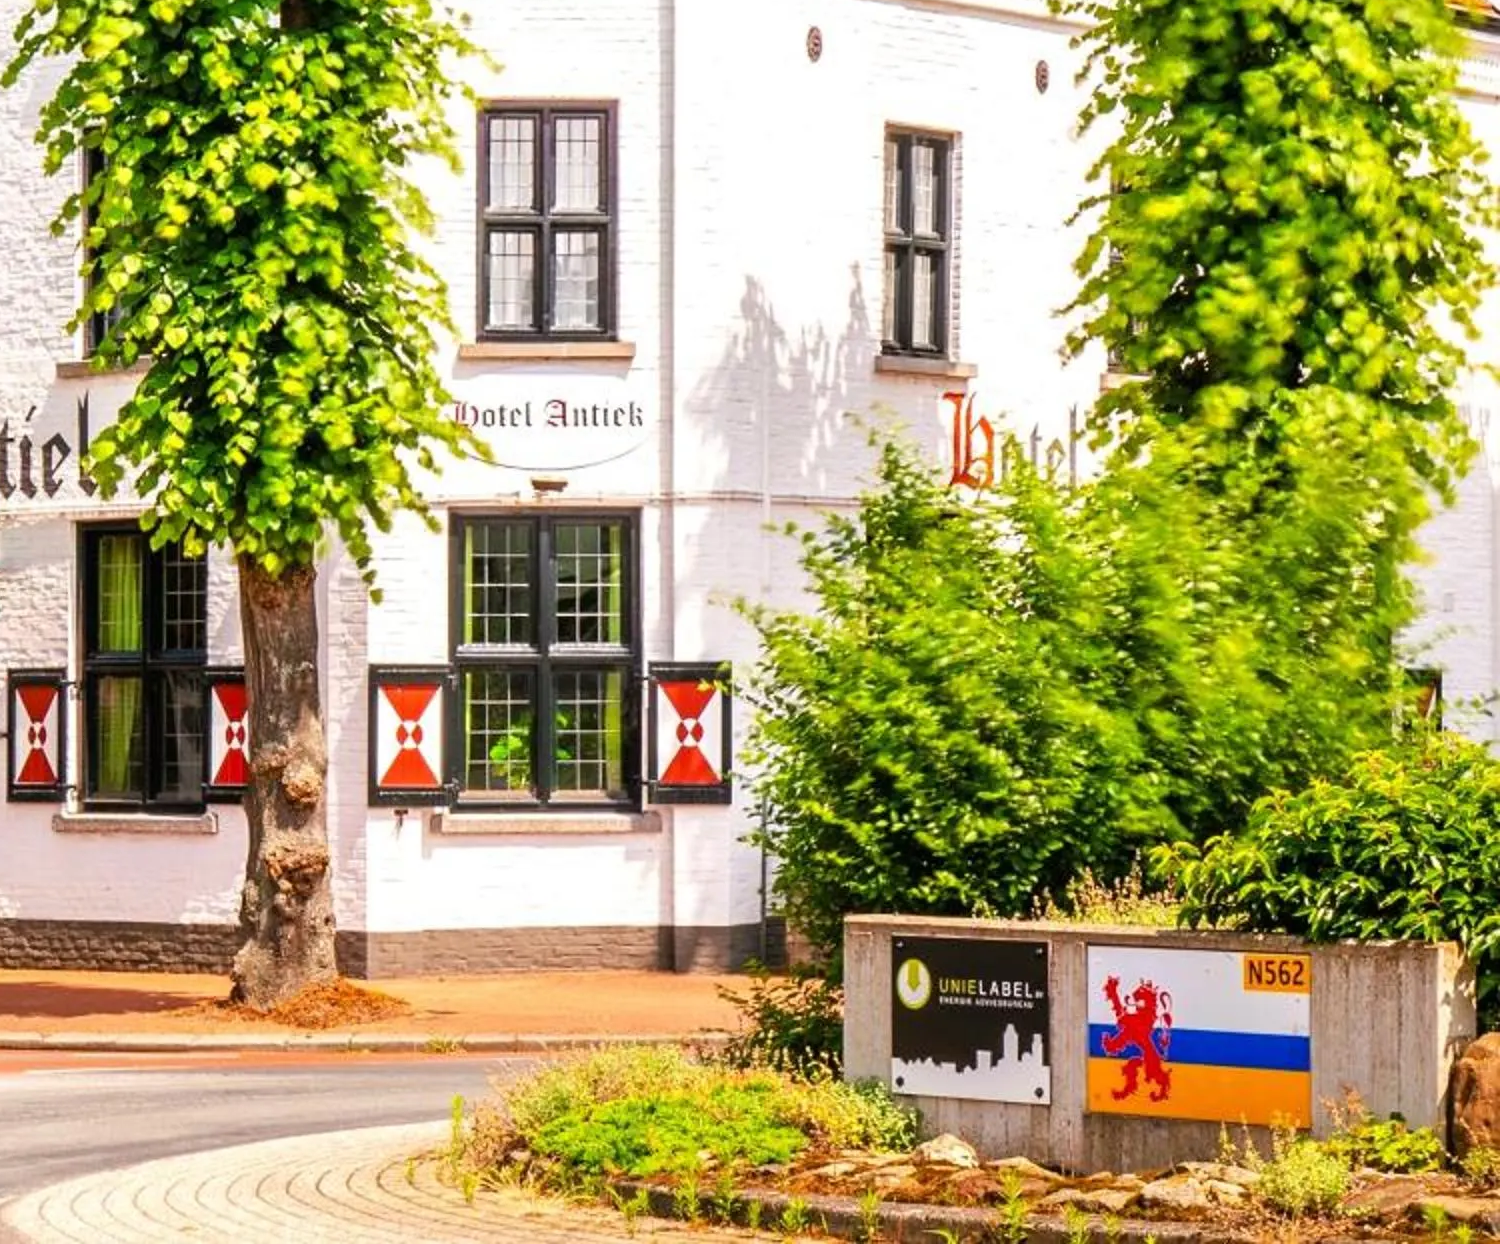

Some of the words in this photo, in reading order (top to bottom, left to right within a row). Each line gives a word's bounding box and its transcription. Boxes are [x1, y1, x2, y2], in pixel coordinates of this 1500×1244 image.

[543, 399, 643, 428] Antiek
[1248, 959, 1304, 986] N562
[939, 977, 1033, 999] UNIELABEL
